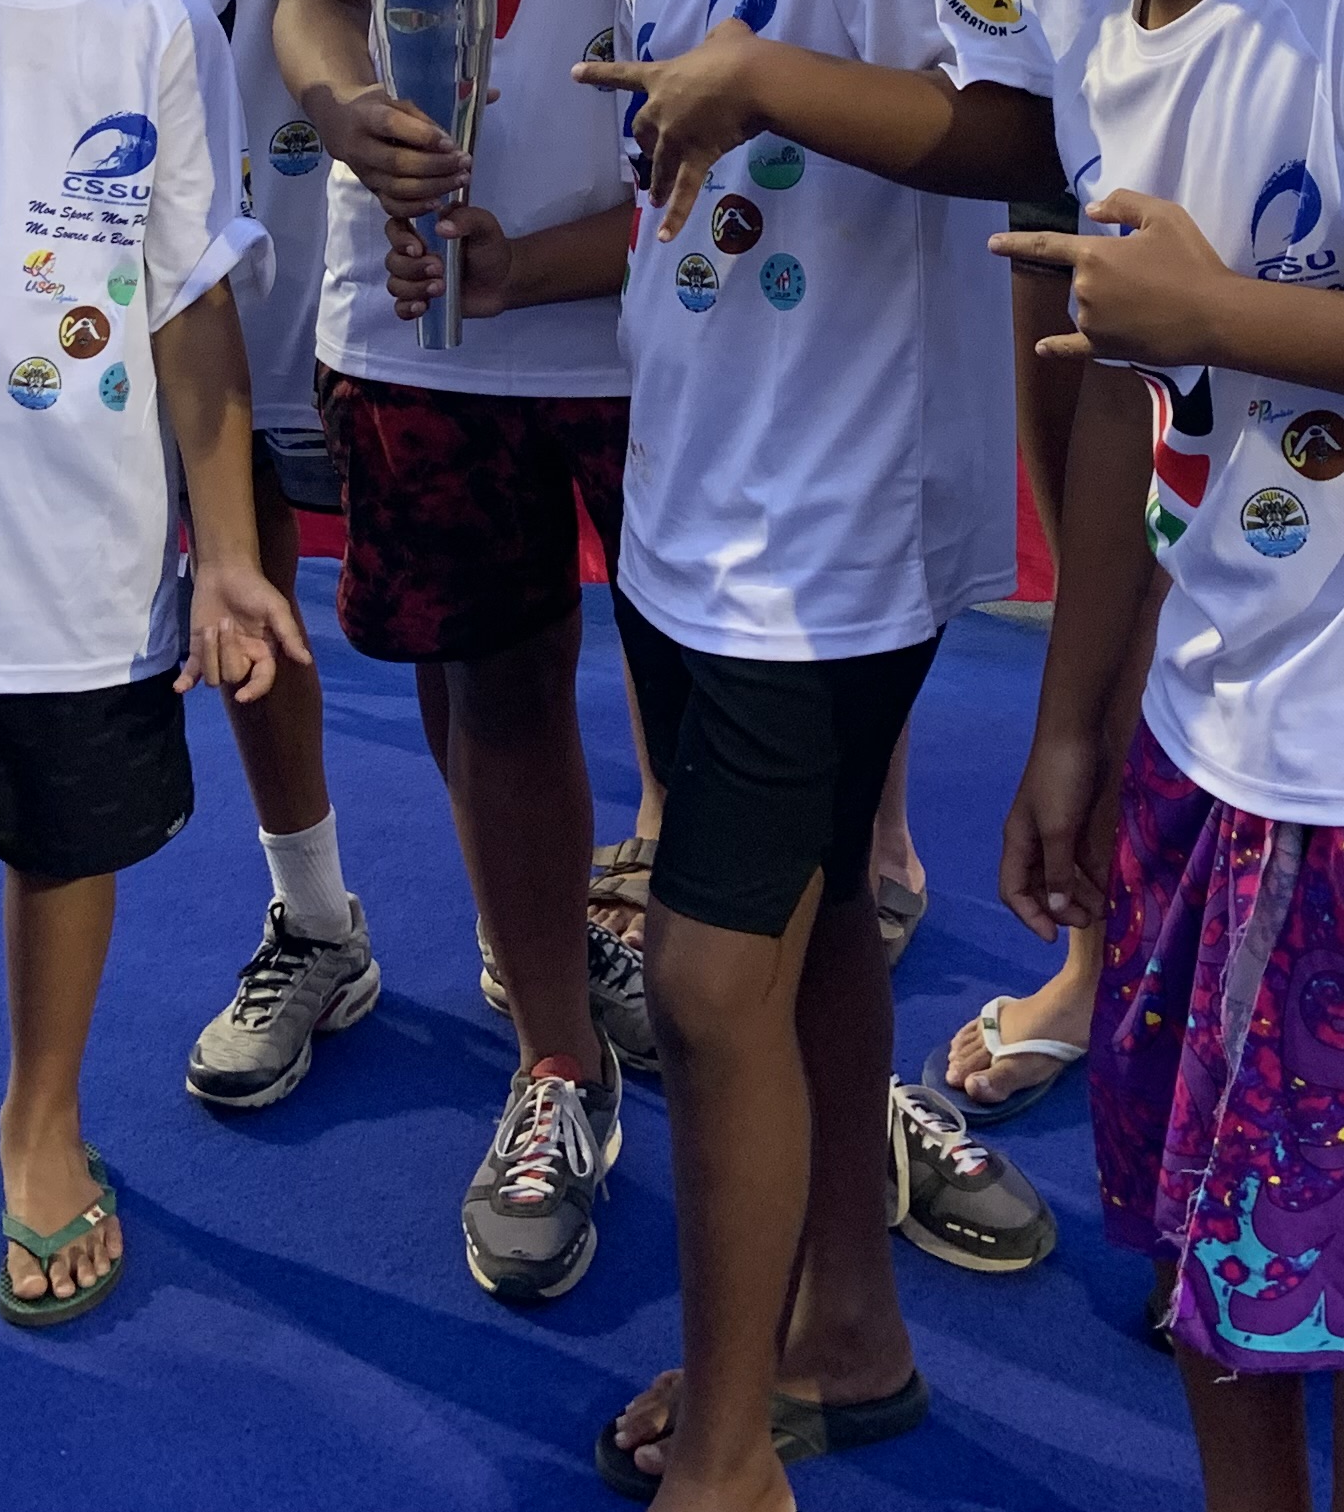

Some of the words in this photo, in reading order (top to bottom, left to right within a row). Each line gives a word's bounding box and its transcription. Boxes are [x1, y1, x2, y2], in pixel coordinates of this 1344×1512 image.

[63, 176, 151, 200] CSSU
[28, 200, 56, 215] Mon
[101, 211, 129, 226] Mon
[25, 221, 48, 236] Ma
[52, 227, 88, 241] Source
[92, 231, 106, 243] de
